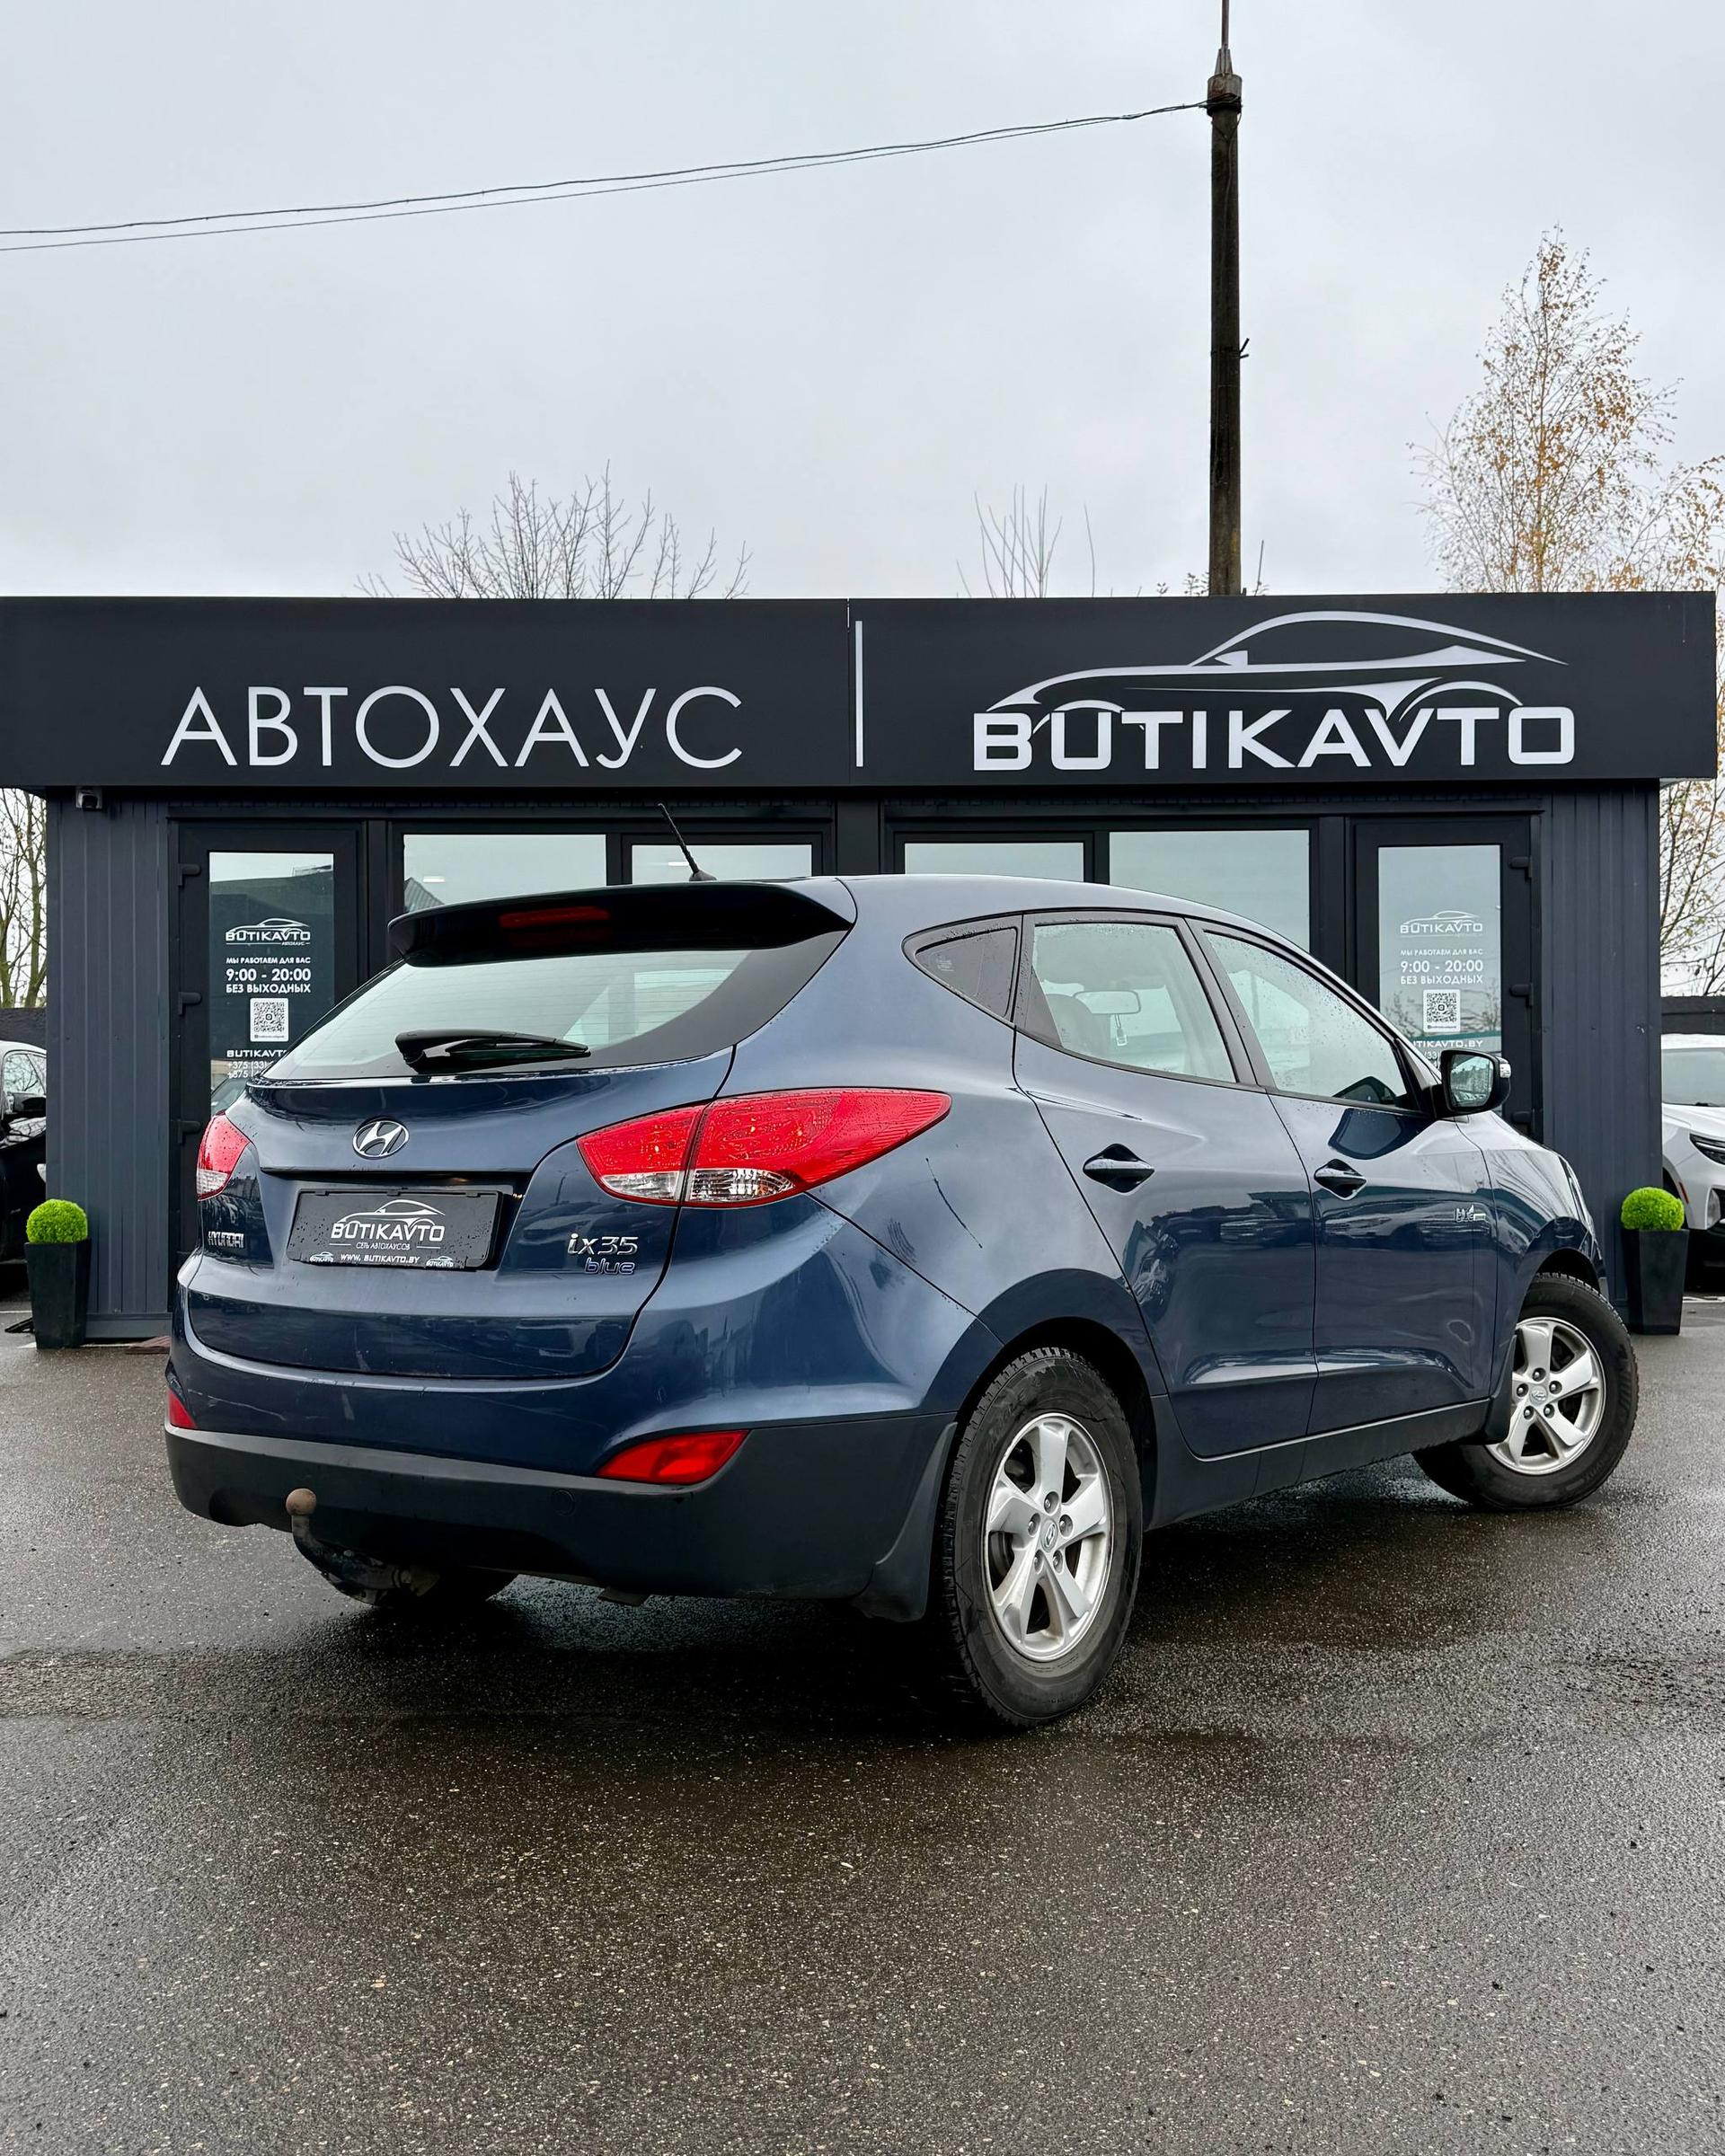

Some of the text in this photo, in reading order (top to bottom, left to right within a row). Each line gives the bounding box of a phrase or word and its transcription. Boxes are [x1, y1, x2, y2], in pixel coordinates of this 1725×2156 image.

[161, 685, 743, 770] АВТОХАУС
[973, 706, 1575, 772] BUTIKAVTO
[1400, 923, 1483, 933] BUTIKAVTO
[226, 931, 311, 941] BUTIKAVTO
[279, 957, 295, 965] ДЛЯ
[1401, 959, 1430, 973] 9:00
[1445, 959, 1483, 973] 20:00
[226, 968, 257, 981] 9:00
[271, 968, 312, 981] 20:00
[1401, 975, 1483, 985] БЕЗ ВЫХОДНЫХ
[226, 984, 312, 994] БЕЗ ВЫХОДНЫХ
[1413, 1039, 1484, 1047] TIKAVTO.BY
[226, 1049, 287, 1057] BUTIKAVT
[331, 1222, 446, 1242] BUTIKAVTO
[567, 1233, 640, 1256] ix35
[584, 1258, 635, 1275] blue
